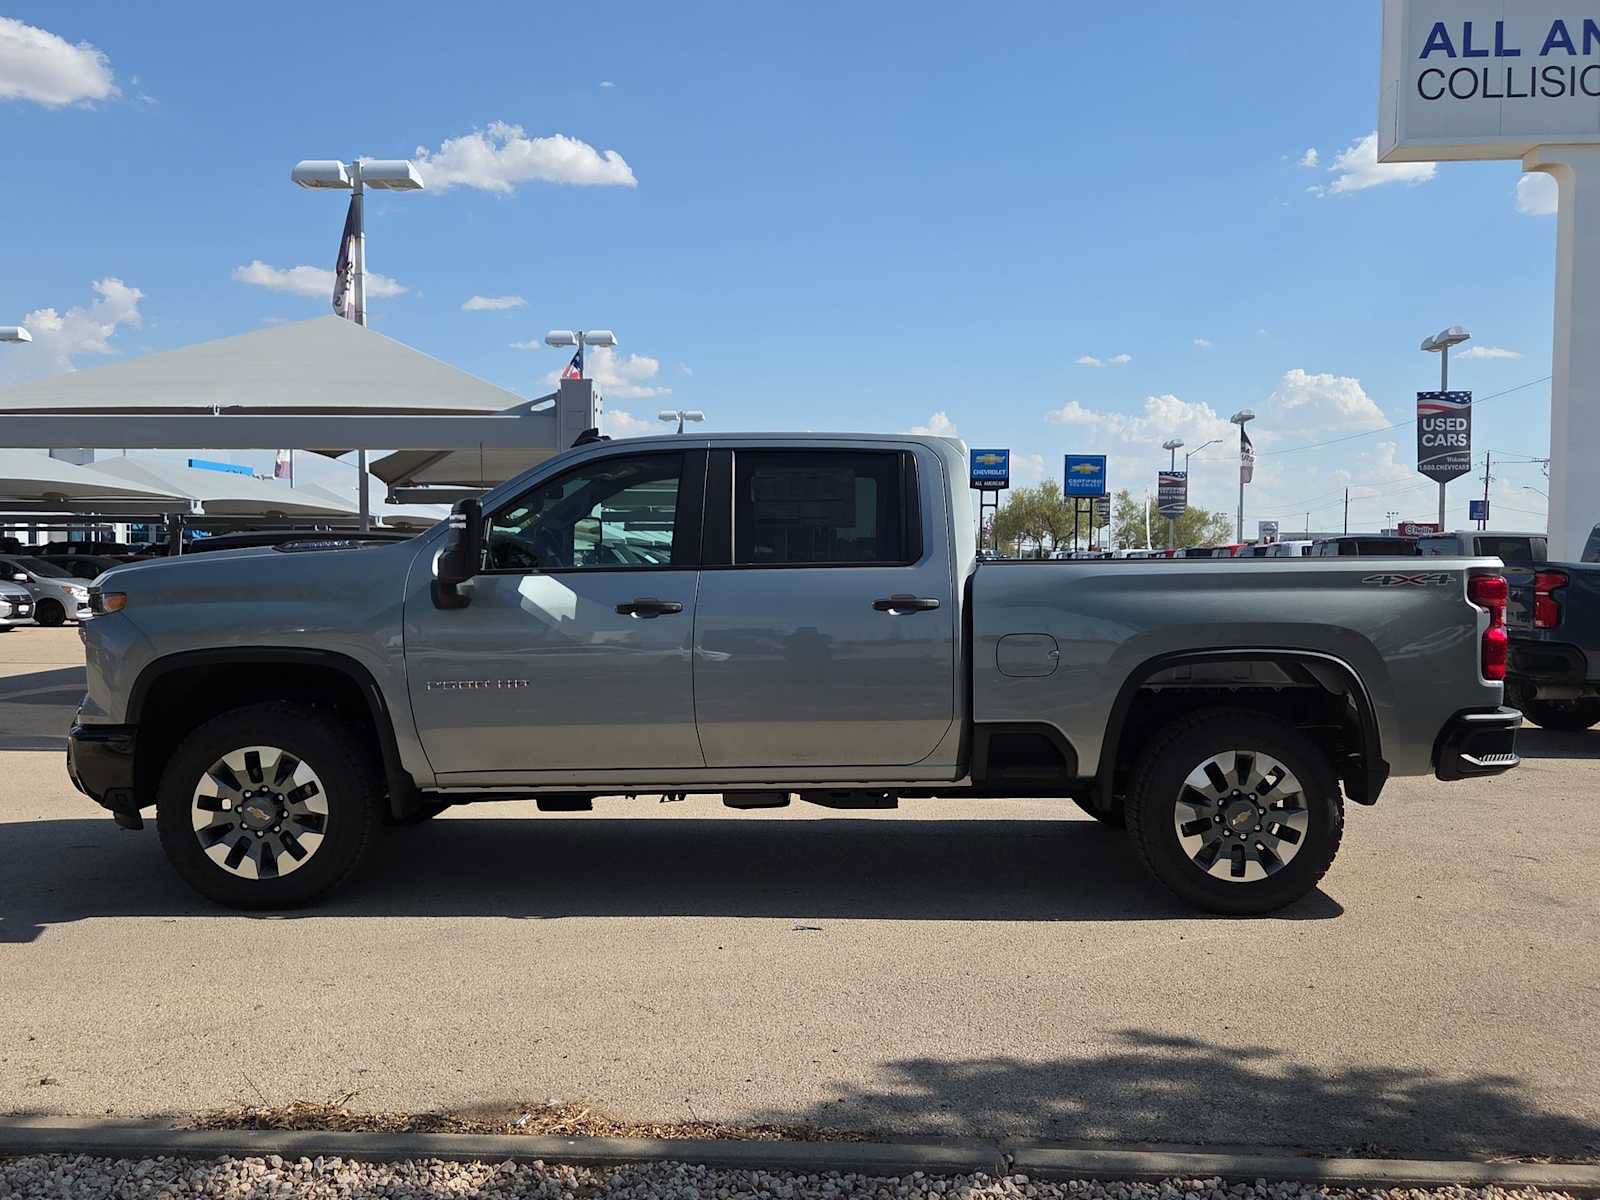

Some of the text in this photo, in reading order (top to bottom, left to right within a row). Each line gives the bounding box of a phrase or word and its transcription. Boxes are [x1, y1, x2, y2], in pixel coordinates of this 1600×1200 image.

[1419, 21, 1521, 59] ALL
[1422, 418, 1467, 431] USED
[1422, 433, 1467, 447] CARS
